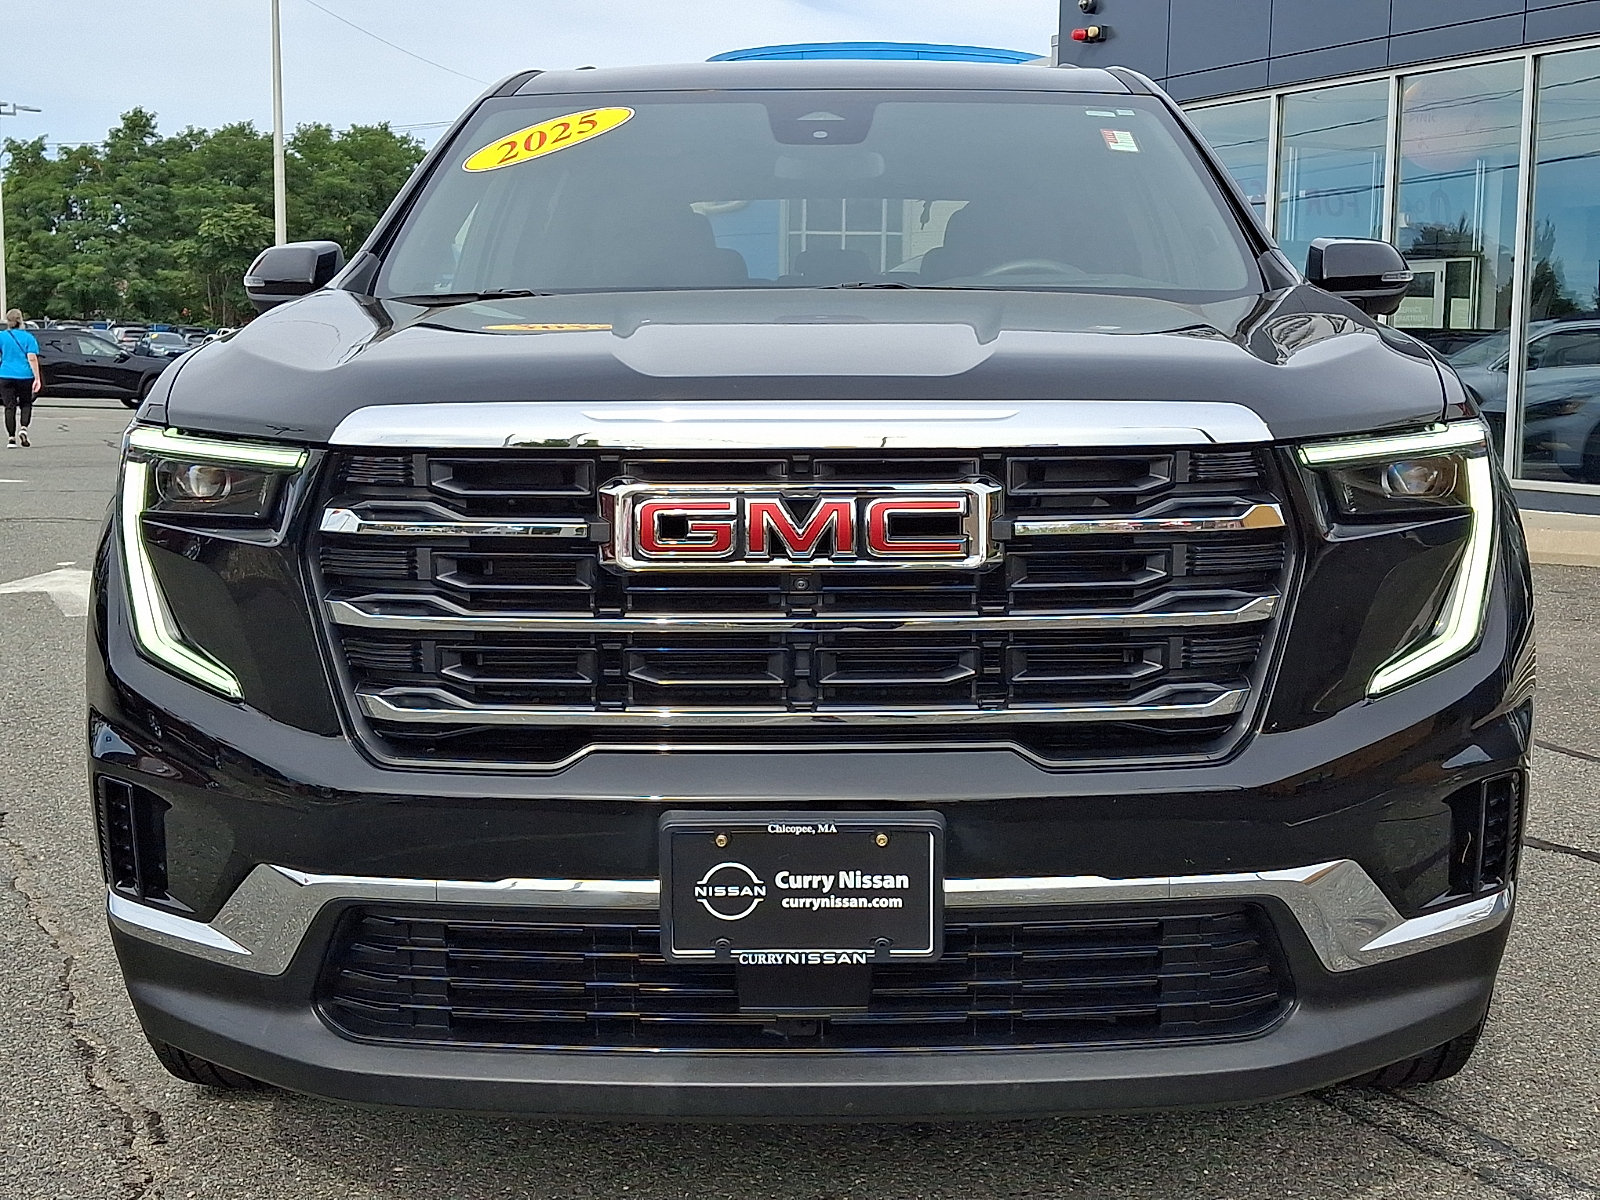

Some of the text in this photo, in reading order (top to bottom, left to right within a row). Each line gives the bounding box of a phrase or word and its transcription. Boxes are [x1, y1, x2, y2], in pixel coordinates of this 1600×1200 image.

[497, 112, 598, 164] 2025
[636, 496, 968, 558] GMC
[767, 823, 837, 834] Chicopee, MA
[775, 870, 909, 893] Curry Nissan
[694, 886, 766, 897] NISSAN
[781, 895, 903, 911] currynissan.com
